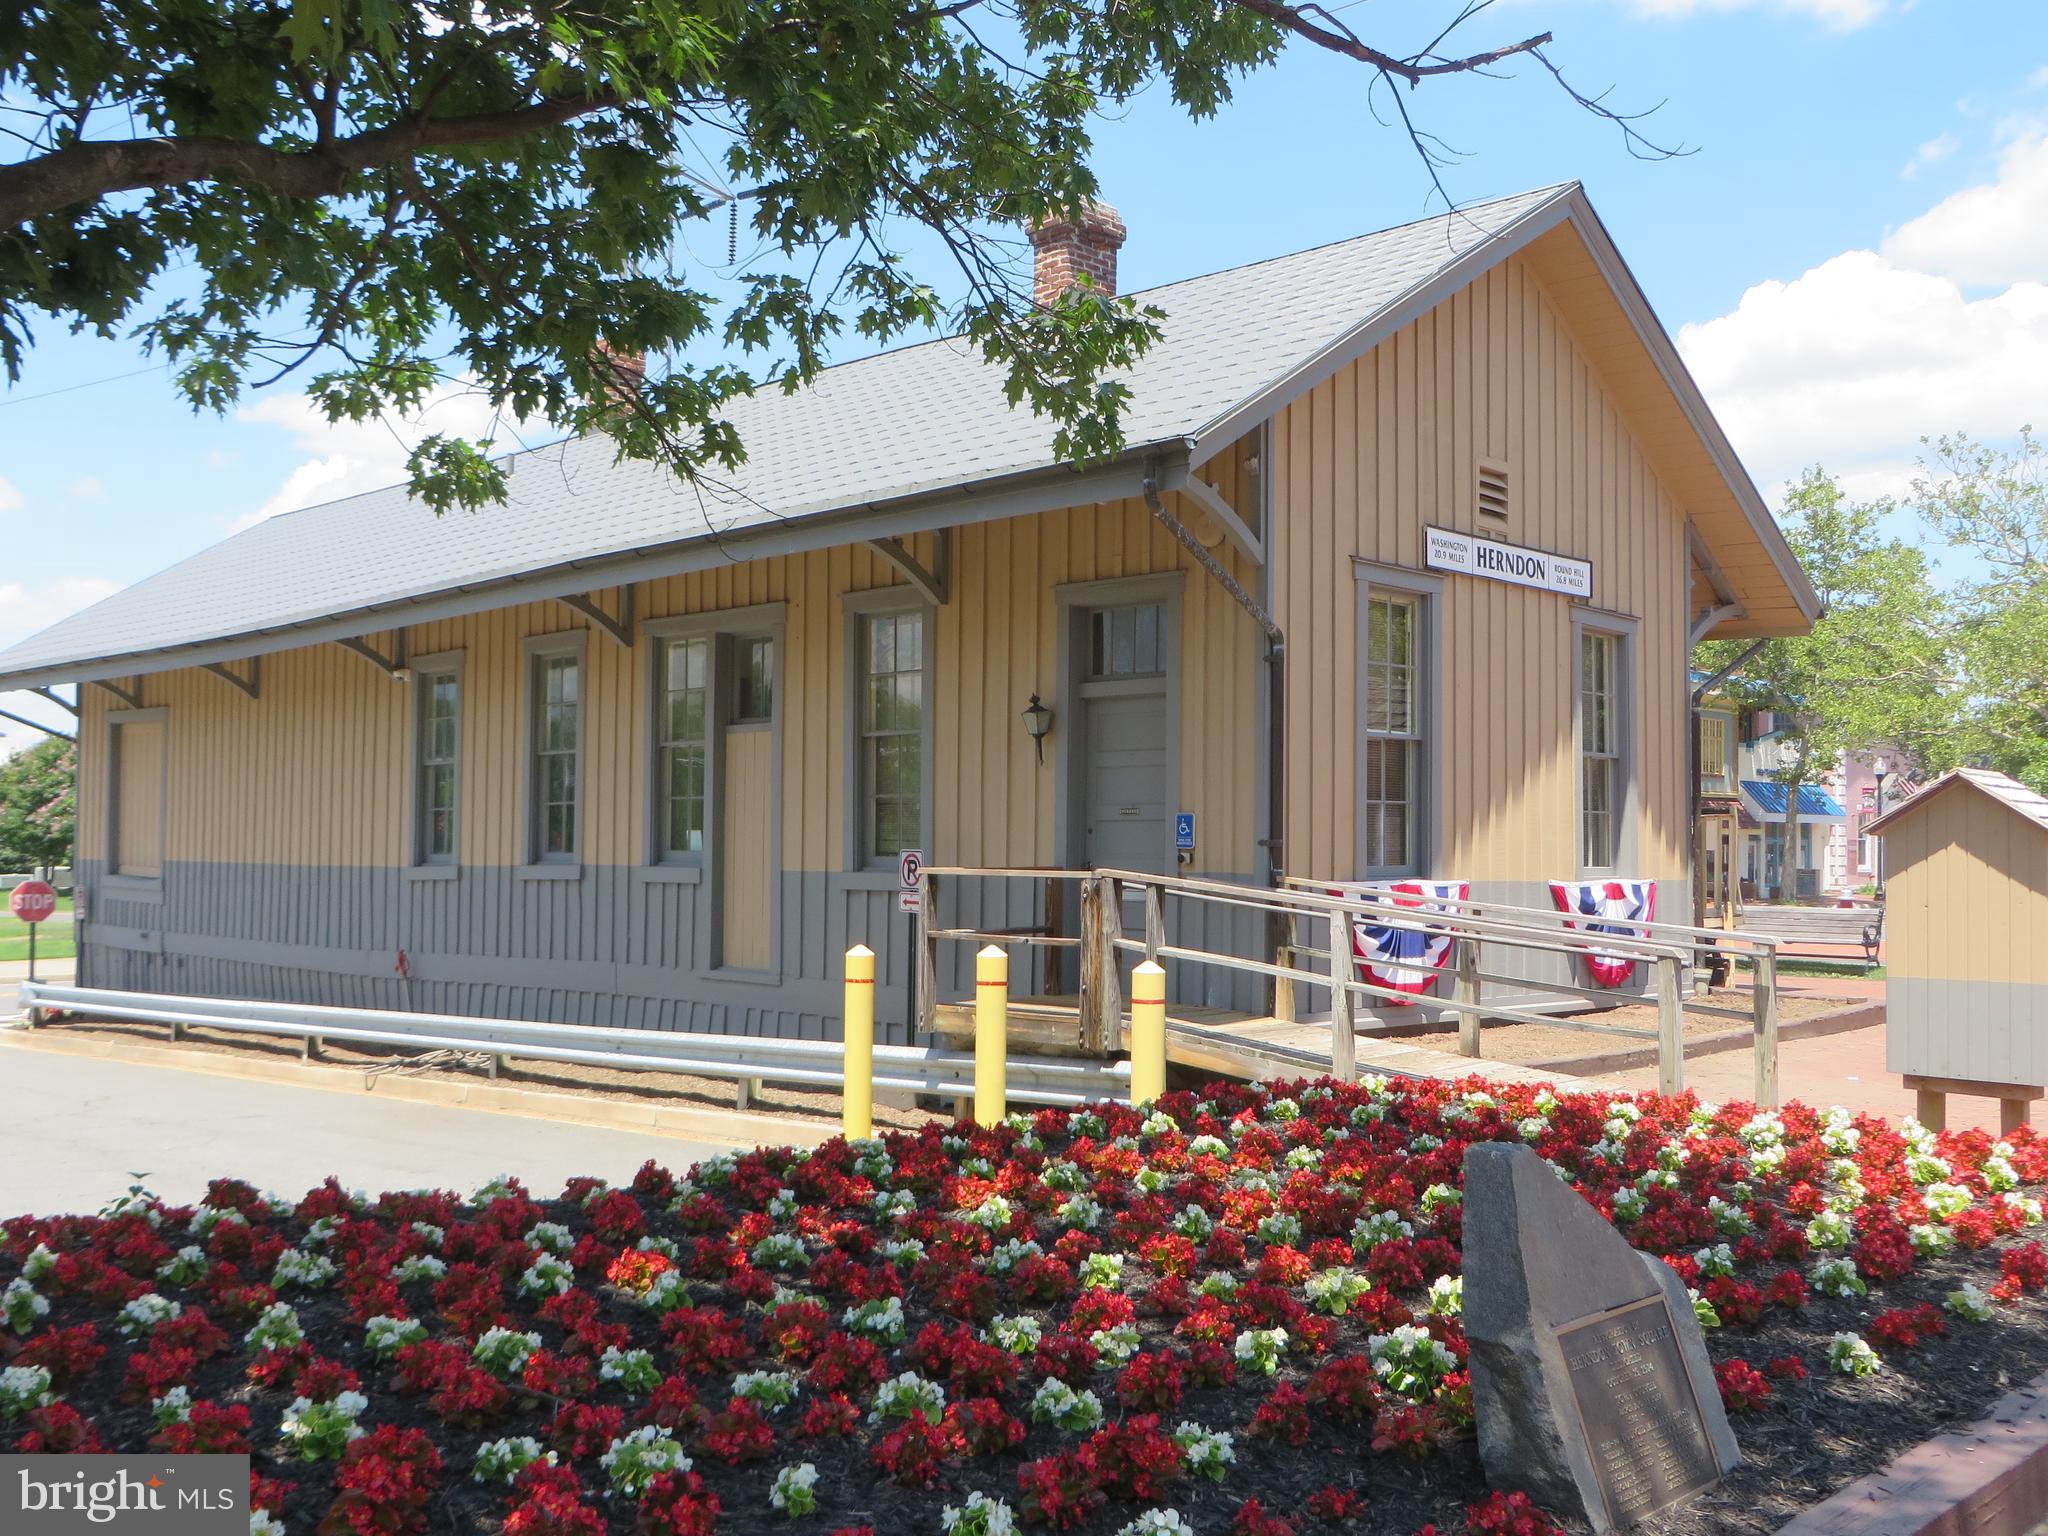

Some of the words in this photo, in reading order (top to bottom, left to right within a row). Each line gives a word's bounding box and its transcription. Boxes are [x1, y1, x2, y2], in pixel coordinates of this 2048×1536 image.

[1430, 536, 1468, 553] WASHINGTON
[1434, 549, 1447, 560] 20.9
[1448, 552, 1465, 564] MILES
[1476, 546, 1546, 580] HERNDON
[1554, 564, 1572, 576] ROUND
[1573, 568, 1585, 578] HILL
[1568, 577, 1584, 588] MILES
[13, 893, 54, 910] STOP
